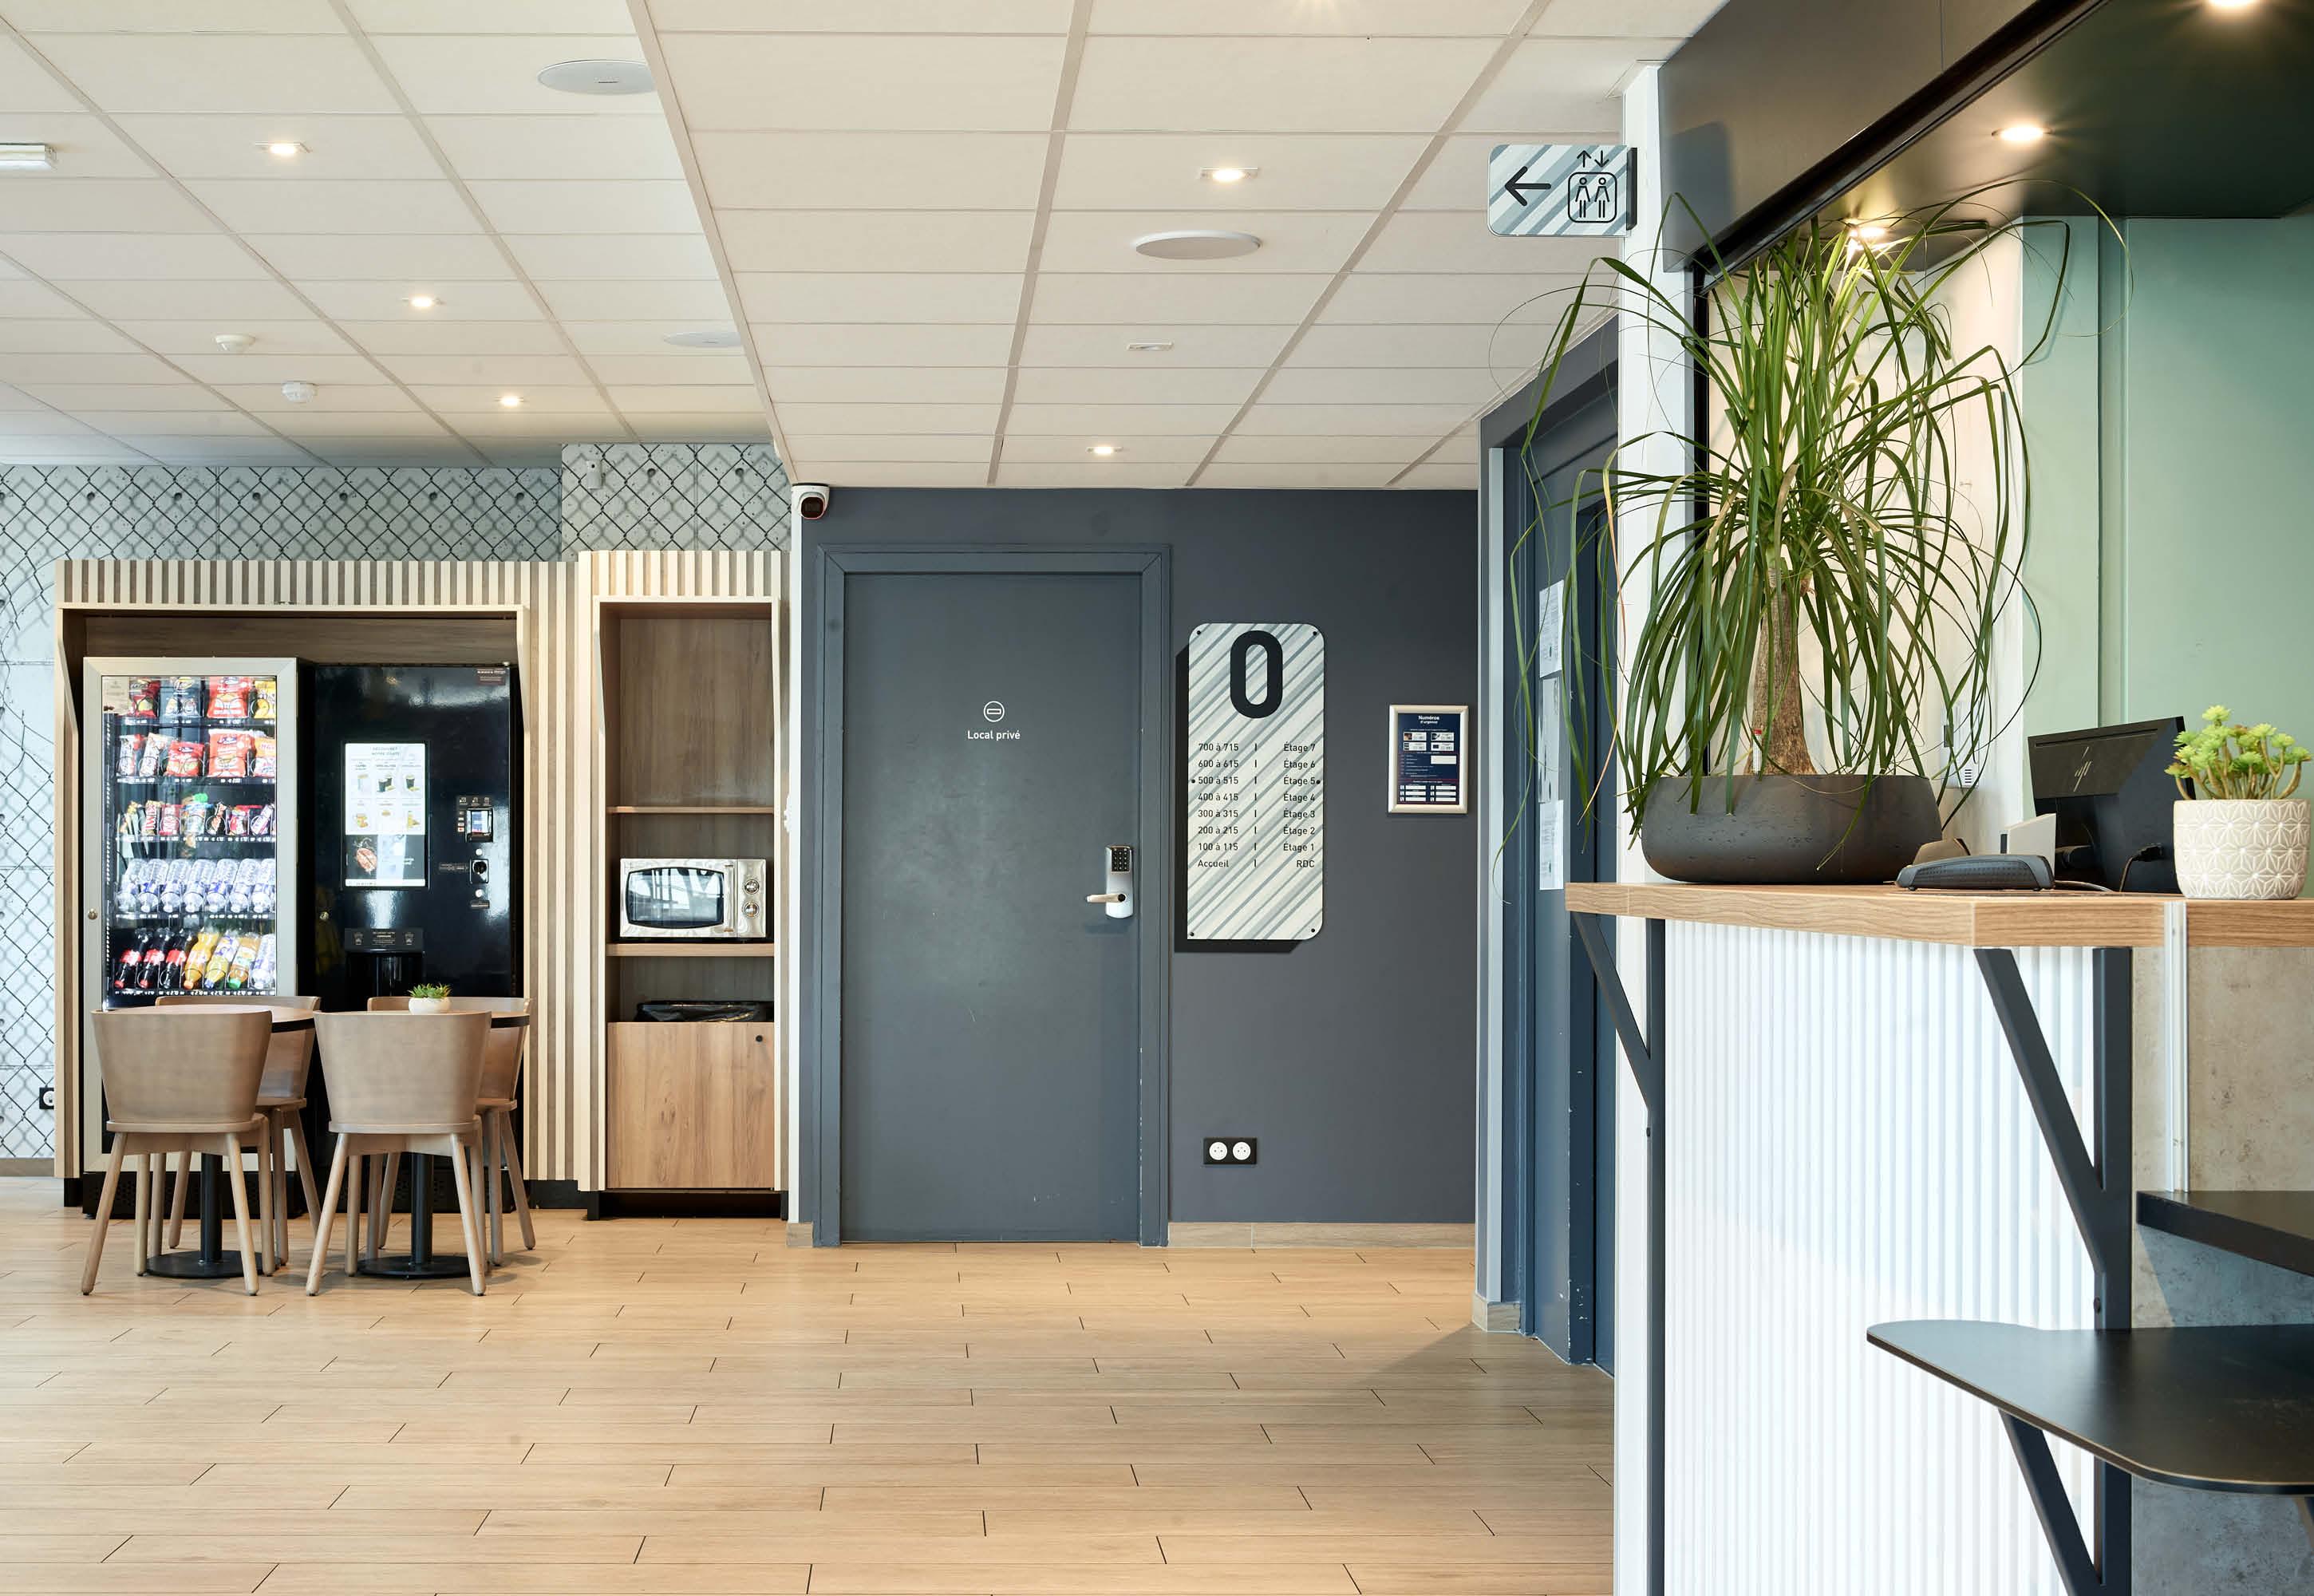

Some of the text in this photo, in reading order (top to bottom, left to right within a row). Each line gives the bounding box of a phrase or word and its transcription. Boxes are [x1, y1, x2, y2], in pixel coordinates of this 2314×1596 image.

[1230, 630, 1283, 719] 0
[967, 729, 1021, 741] Local privé
[1216, 742, 1221, 752] à
[1283, 742, 1308, 753] Étage
[1216, 759, 1221, 768] à
[1283, 758, 1308, 769] Étage
[1216, 776, 1221, 784] à
[1283, 775, 1308, 786] Étage
[1216, 792, 1221, 801] à
[1283, 792, 1308, 803] Étage
[1216, 809, 1221, 818] à
[1283, 808, 1308, 820] Étage
[1215, 826, 1220, 835] à
[1283, 825, 1307, 836] Étage
[1215, 842, 1220, 851] à
[1283, 841, 1307, 852] Étage
[1198, 859, 1229, 868] Accueil
